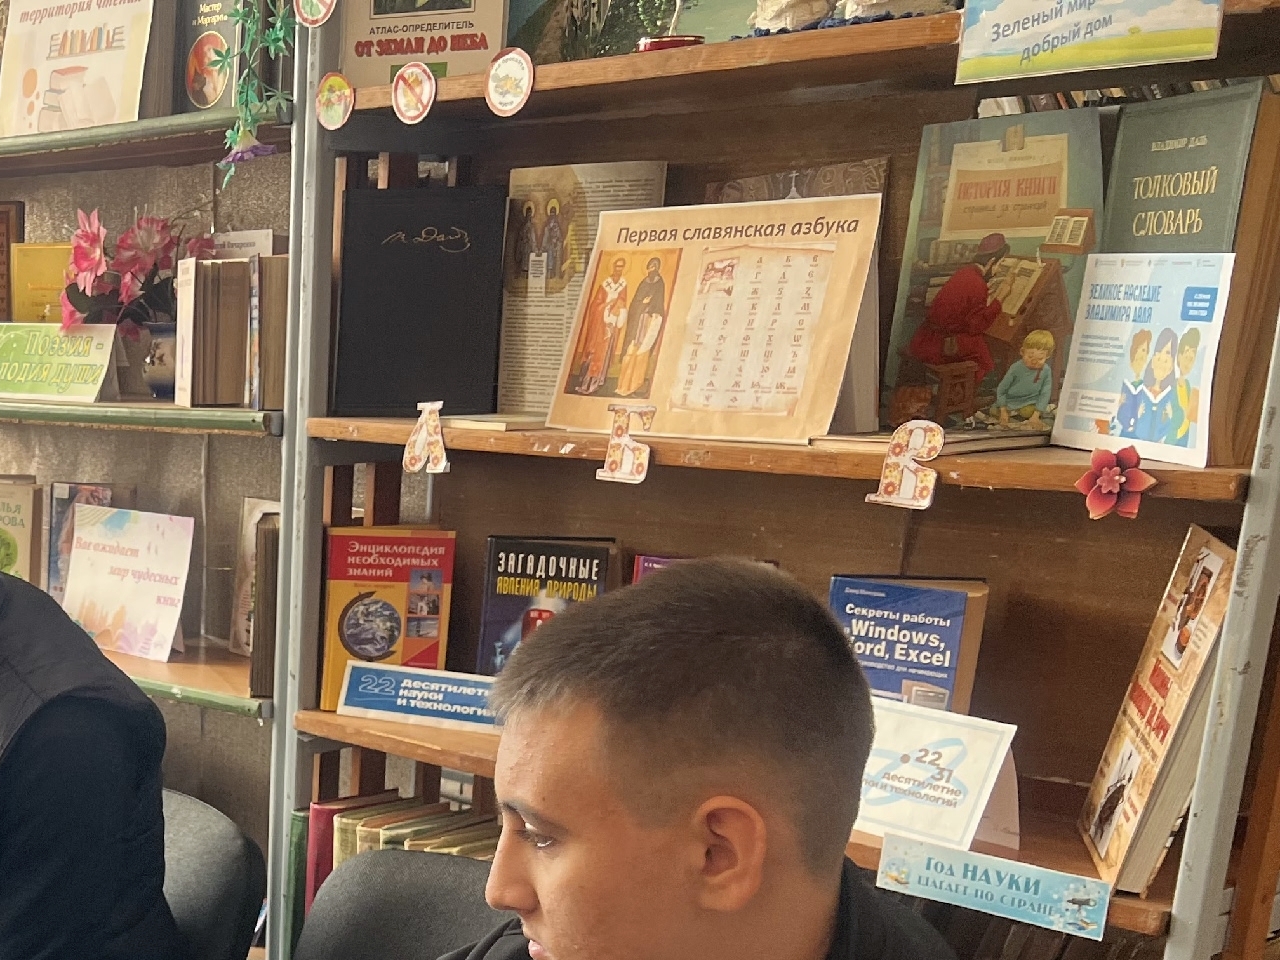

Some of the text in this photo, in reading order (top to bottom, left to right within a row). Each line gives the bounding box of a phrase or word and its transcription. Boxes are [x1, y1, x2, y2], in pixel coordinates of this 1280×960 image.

[20, 0, 92, 24] территория
[990, 0, 1064, 43] Зеленый
[369, 20, 475, 35] АТЛАС-ОПРЕДЕЛИТЕЛЬ
[1019, 13, 1114, 66] добрый дом
[354, 40, 375, 57] ОТ
[427, 34, 448, 55] ДО
[1132, 166, 1219, 200] ТОЛКОВЫЙ
[616, 217, 860, 246] Первая славянская азбука
[1132, 209, 1204, 237] СЛОВАРЬ
[24, 330, 94, 357] Поэзия
[50, 364, 103, 393] души
[74, 536, 140, 558] Вас ожидает
[130, 567, 181, 586] чудесных
[497, 551, 600, 581] ЗАГАДОЧНЫЕ
[496, 576, 598, 602] ЯВЛЕНИЯ ПРИРОДЫ
[845, 603, 951, 628] Секреты работы
[851, 618, 946, 651] Windows,
[894, 643, 951, 668] Excel
[358, 674, 396, 696] 22
[398, 689, 444, 701] науки
[915, 748, 943, 767] 22
[882, 771, 962, 798] десятилетие
[930, 766, 954, 784] 31
[889, 785, 958, 809] технологий
[962, 862, 1042, 896] НАУКИ
[917, 875, 1055, 917] ШАГАЕТ ПО СТРАНЕ
